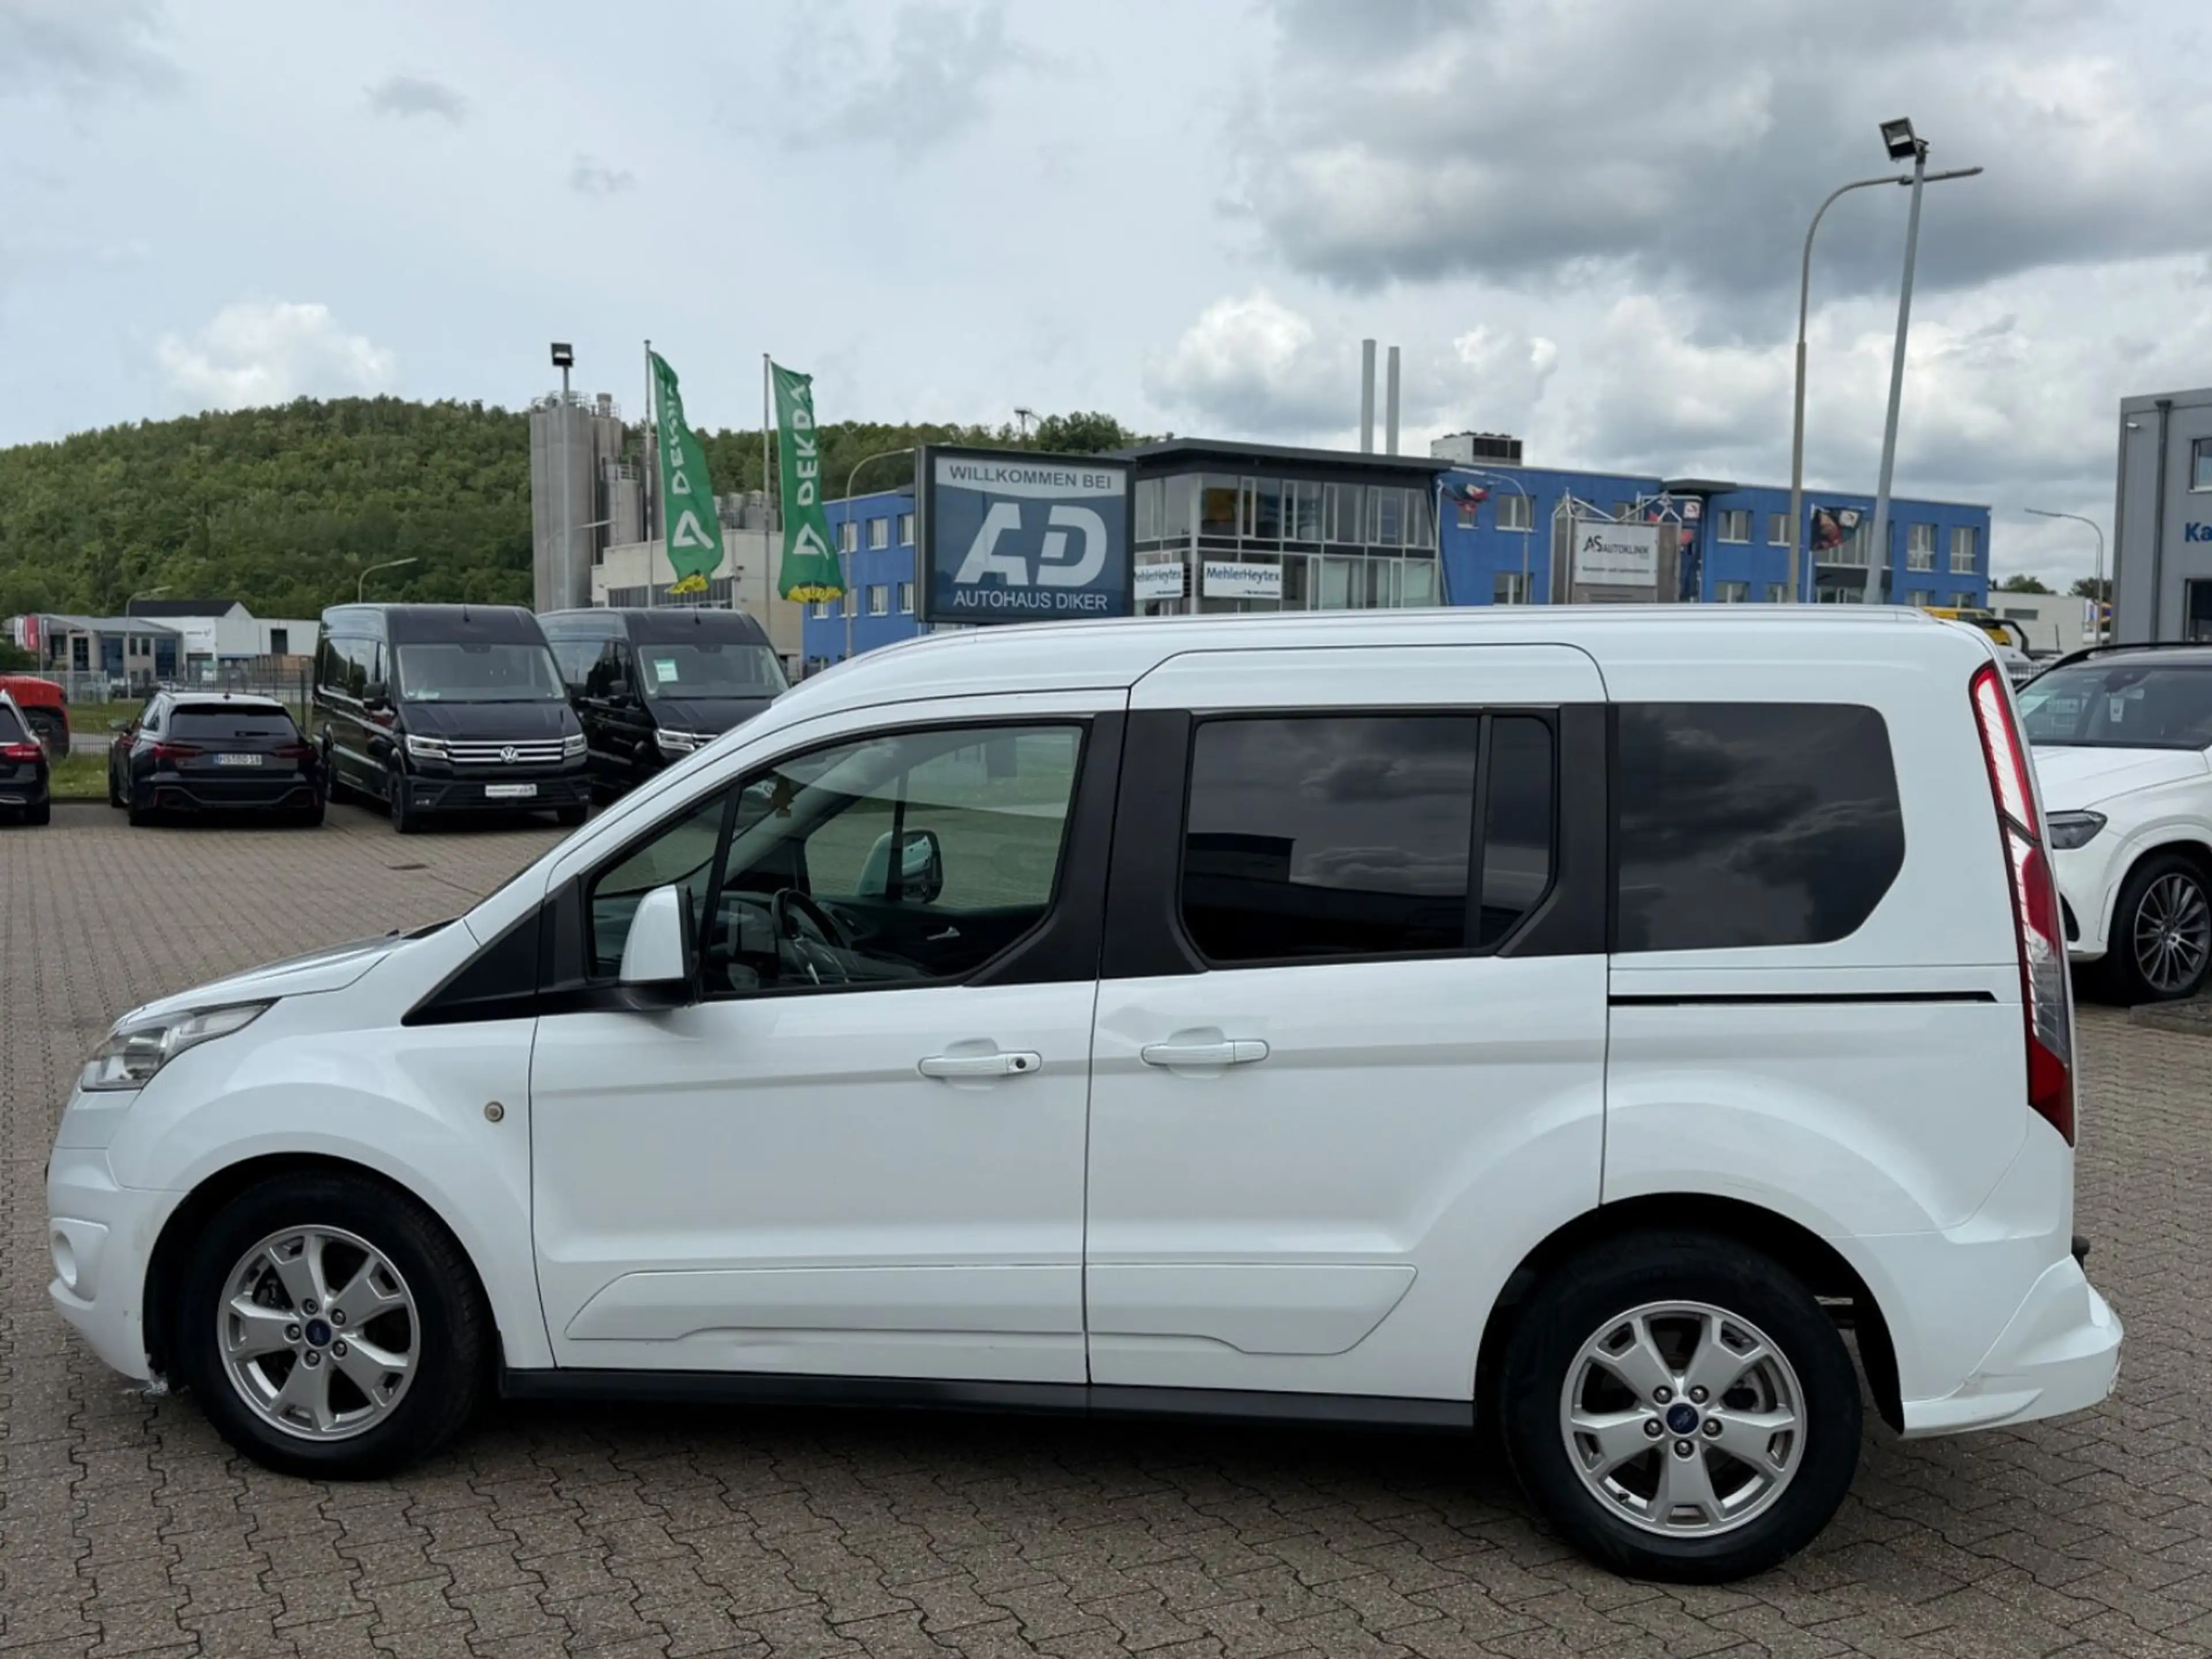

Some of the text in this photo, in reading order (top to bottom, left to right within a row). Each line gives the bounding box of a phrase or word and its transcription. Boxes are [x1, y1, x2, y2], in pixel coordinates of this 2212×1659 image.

[949, 465, 1112, 490] WILLKOMMEN BEI
[953, 502, 1108, 588] AD
[1206, 567, 1280, 584] MehlerHeytex
[953, 590, 1108, 611] AUTOHAUS DIKER
